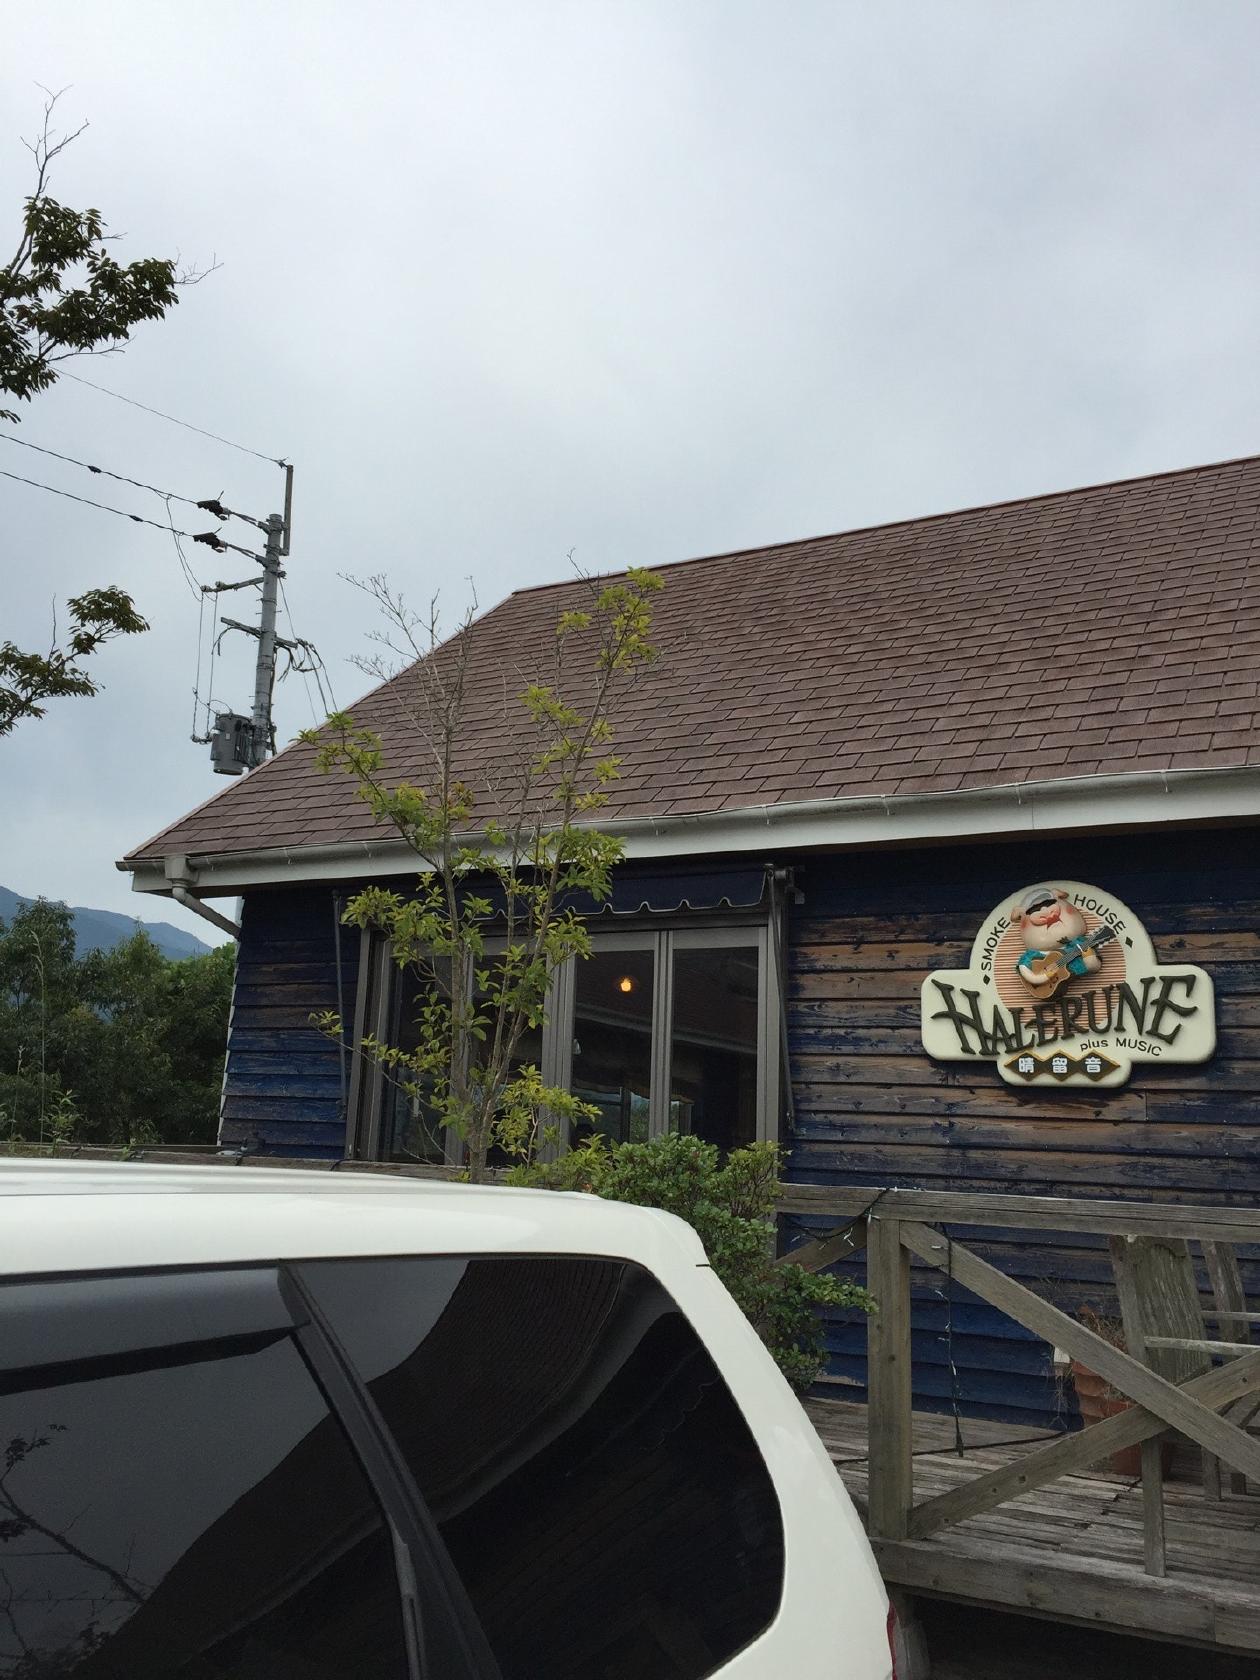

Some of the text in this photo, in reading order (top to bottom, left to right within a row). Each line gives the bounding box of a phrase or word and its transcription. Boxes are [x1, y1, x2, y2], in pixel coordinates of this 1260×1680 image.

[981, 893, 1127, 971] SMOKE HOUSE
[931, 973, 1198, 1056] HALERUNE
[1080, 1037, 1162, 1057] plus MUSIC
